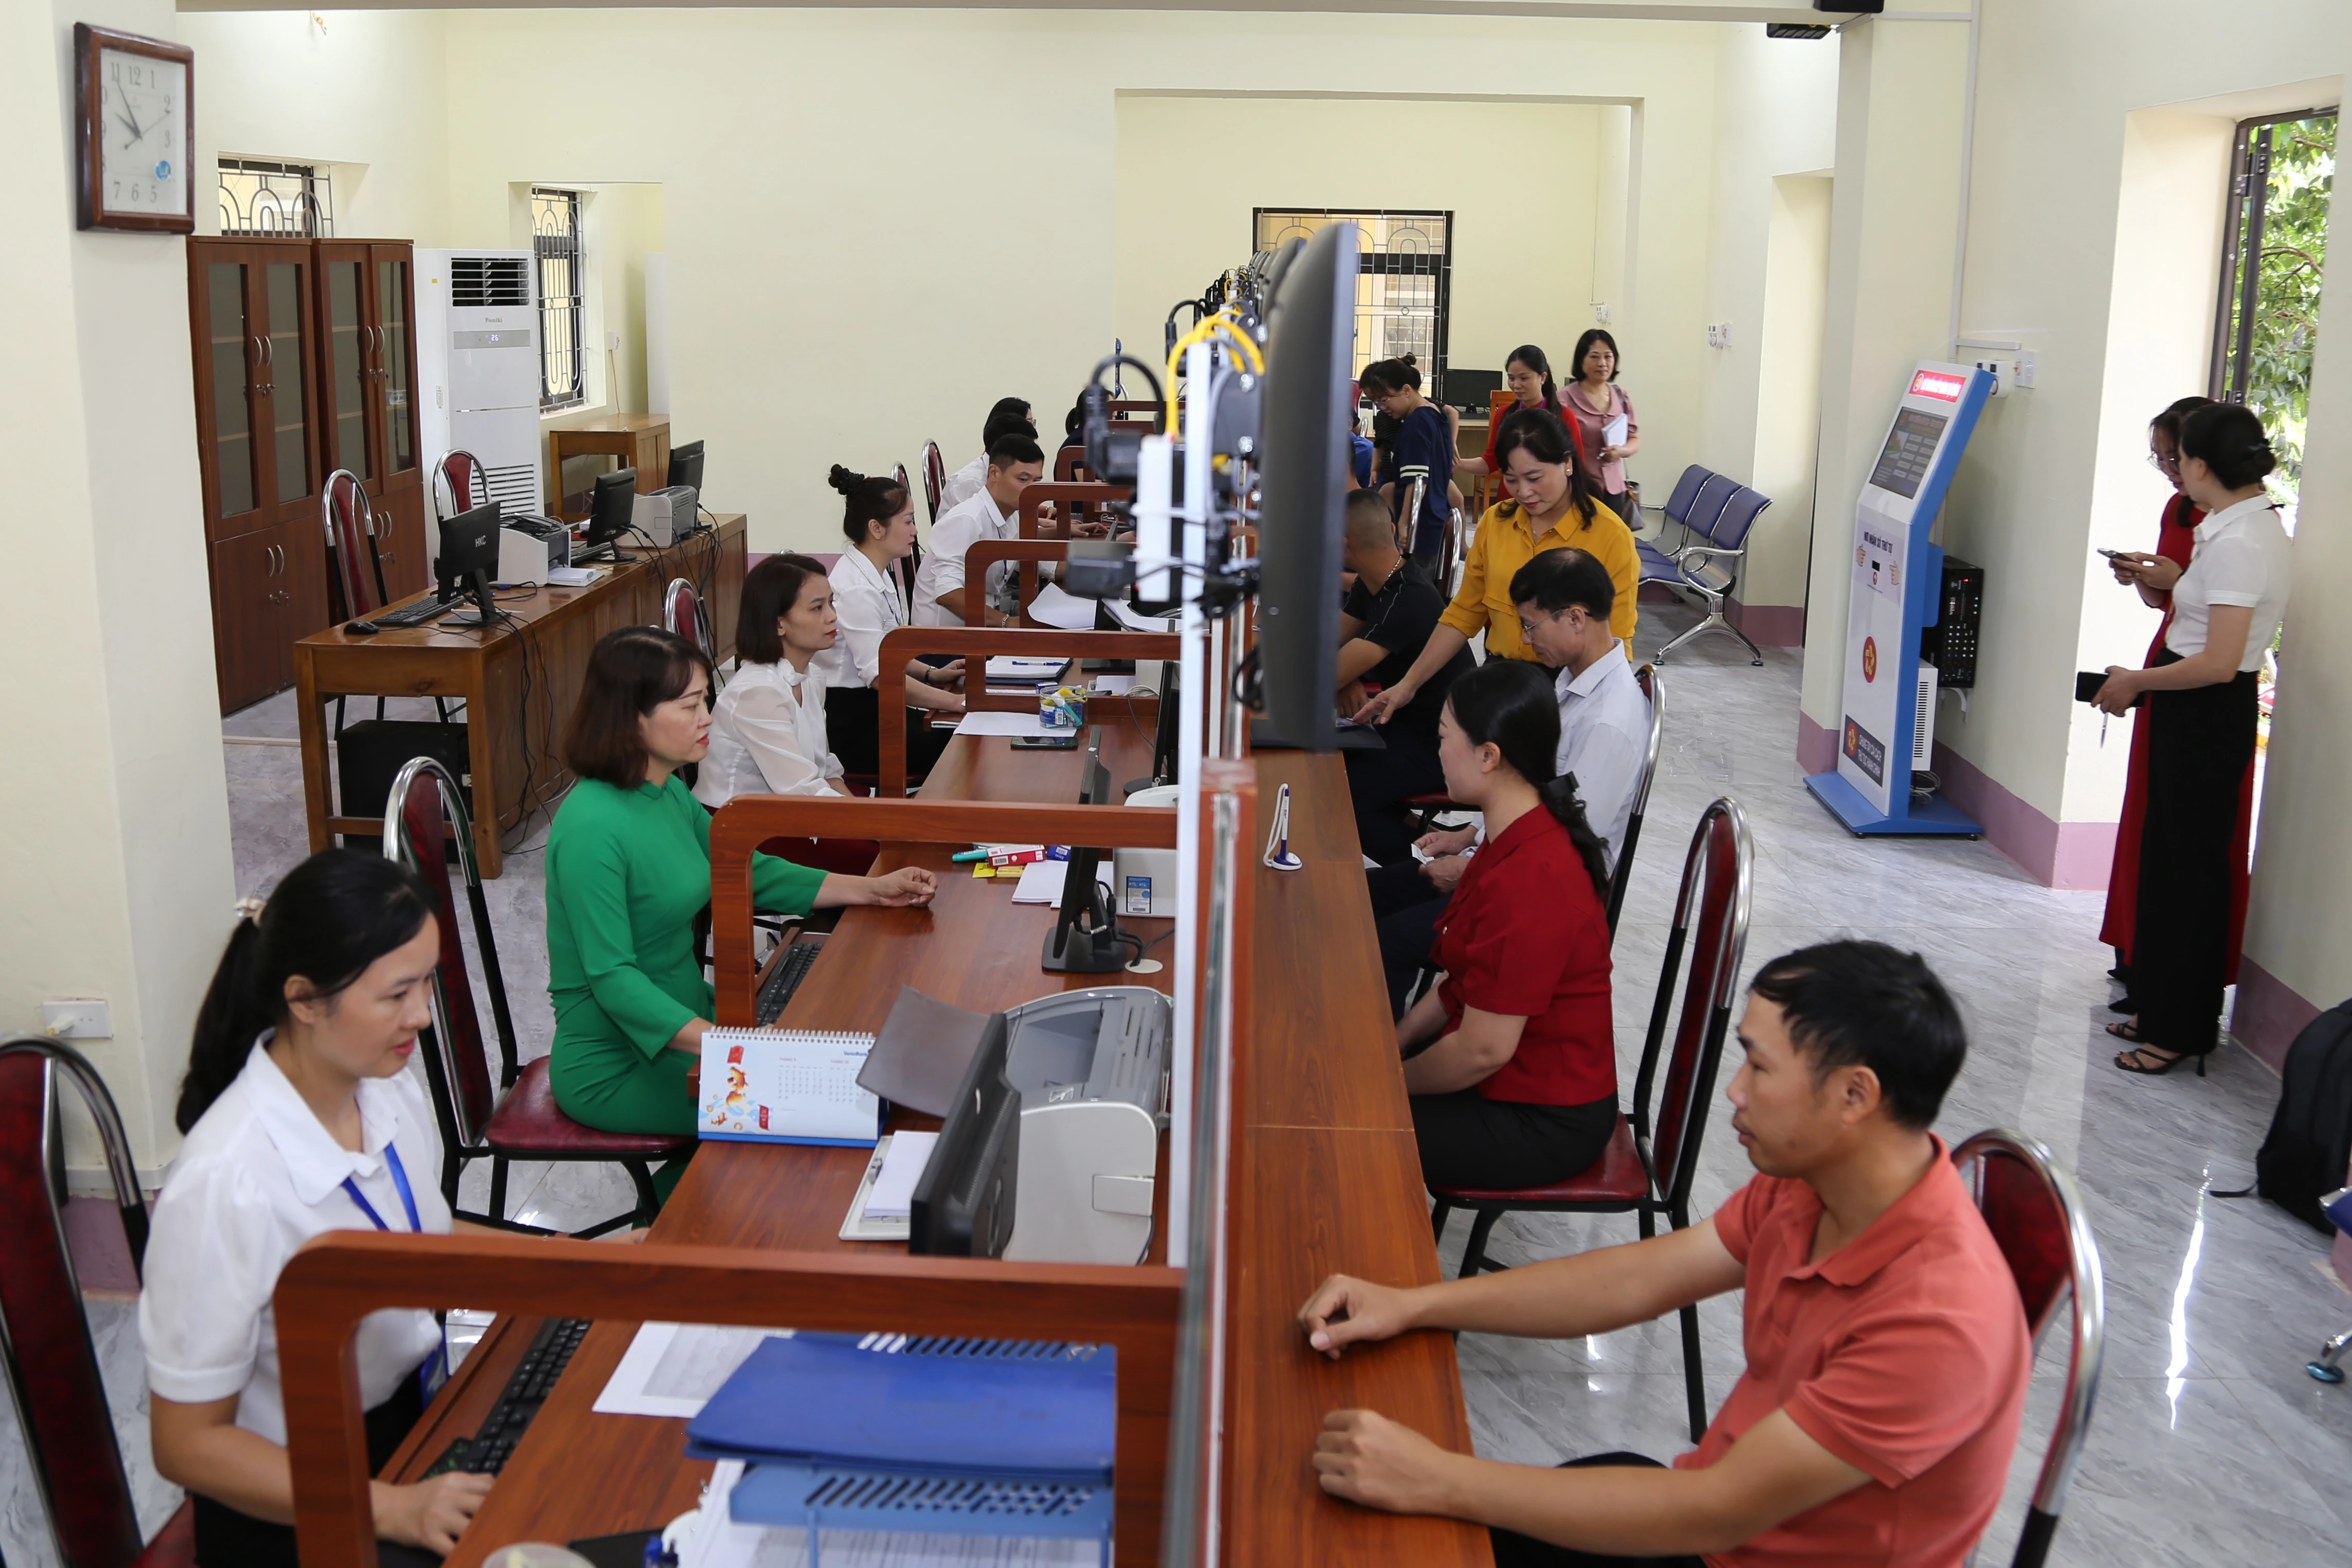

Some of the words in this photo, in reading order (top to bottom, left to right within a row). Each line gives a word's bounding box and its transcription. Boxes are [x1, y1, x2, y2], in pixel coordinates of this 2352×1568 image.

[112, 62, 120, 82] 11
[129, 65, 141, 86] 12
[151, 70, 155, 90] 1
[164, 95, 170, 114] 2
[165, 130, 170, 148] 3
[114, 181, 120, 200] 7
[131, 183, 139, 202] 6
[150, 185, 156, 204] 5
[476, 535, 486, 548] HKC
